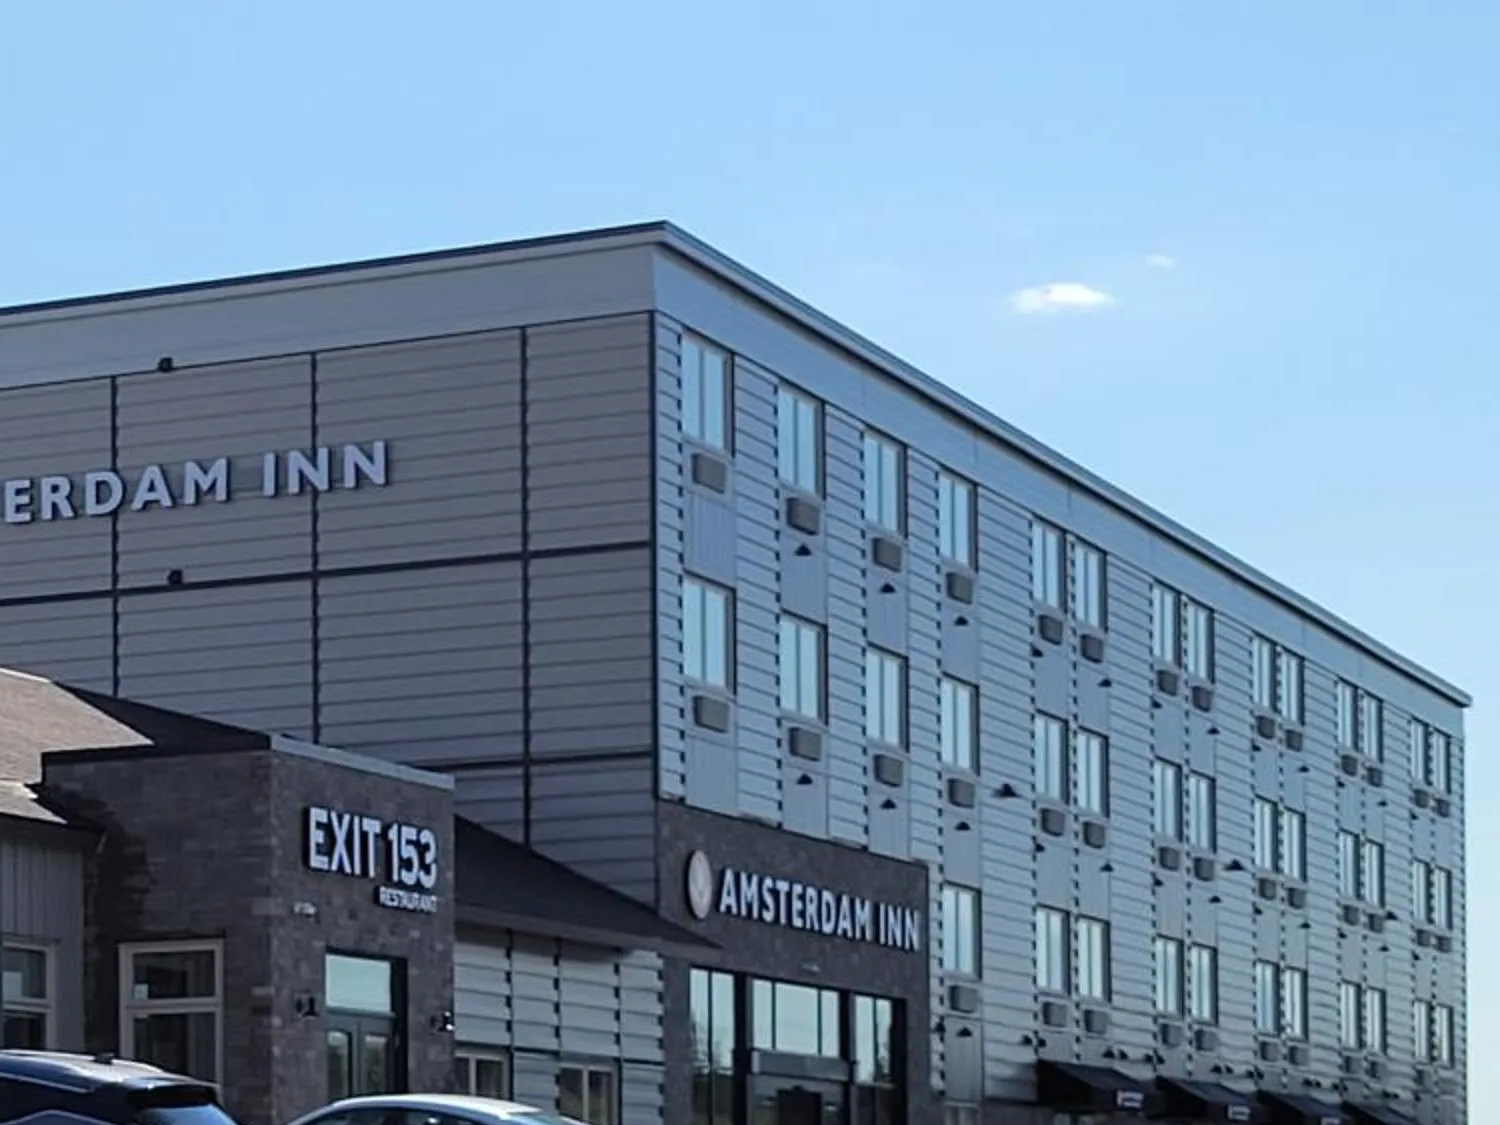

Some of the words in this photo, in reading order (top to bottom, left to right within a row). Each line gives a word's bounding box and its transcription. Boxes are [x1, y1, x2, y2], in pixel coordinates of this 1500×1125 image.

[263, 440, 386, 497] INN
[309, 806, 381, 878] EXIT
[387, 823, 437, 889] 153
[719, 867, 872, 941] AMSTERDAM
[879, 903, 920, 950] INN
